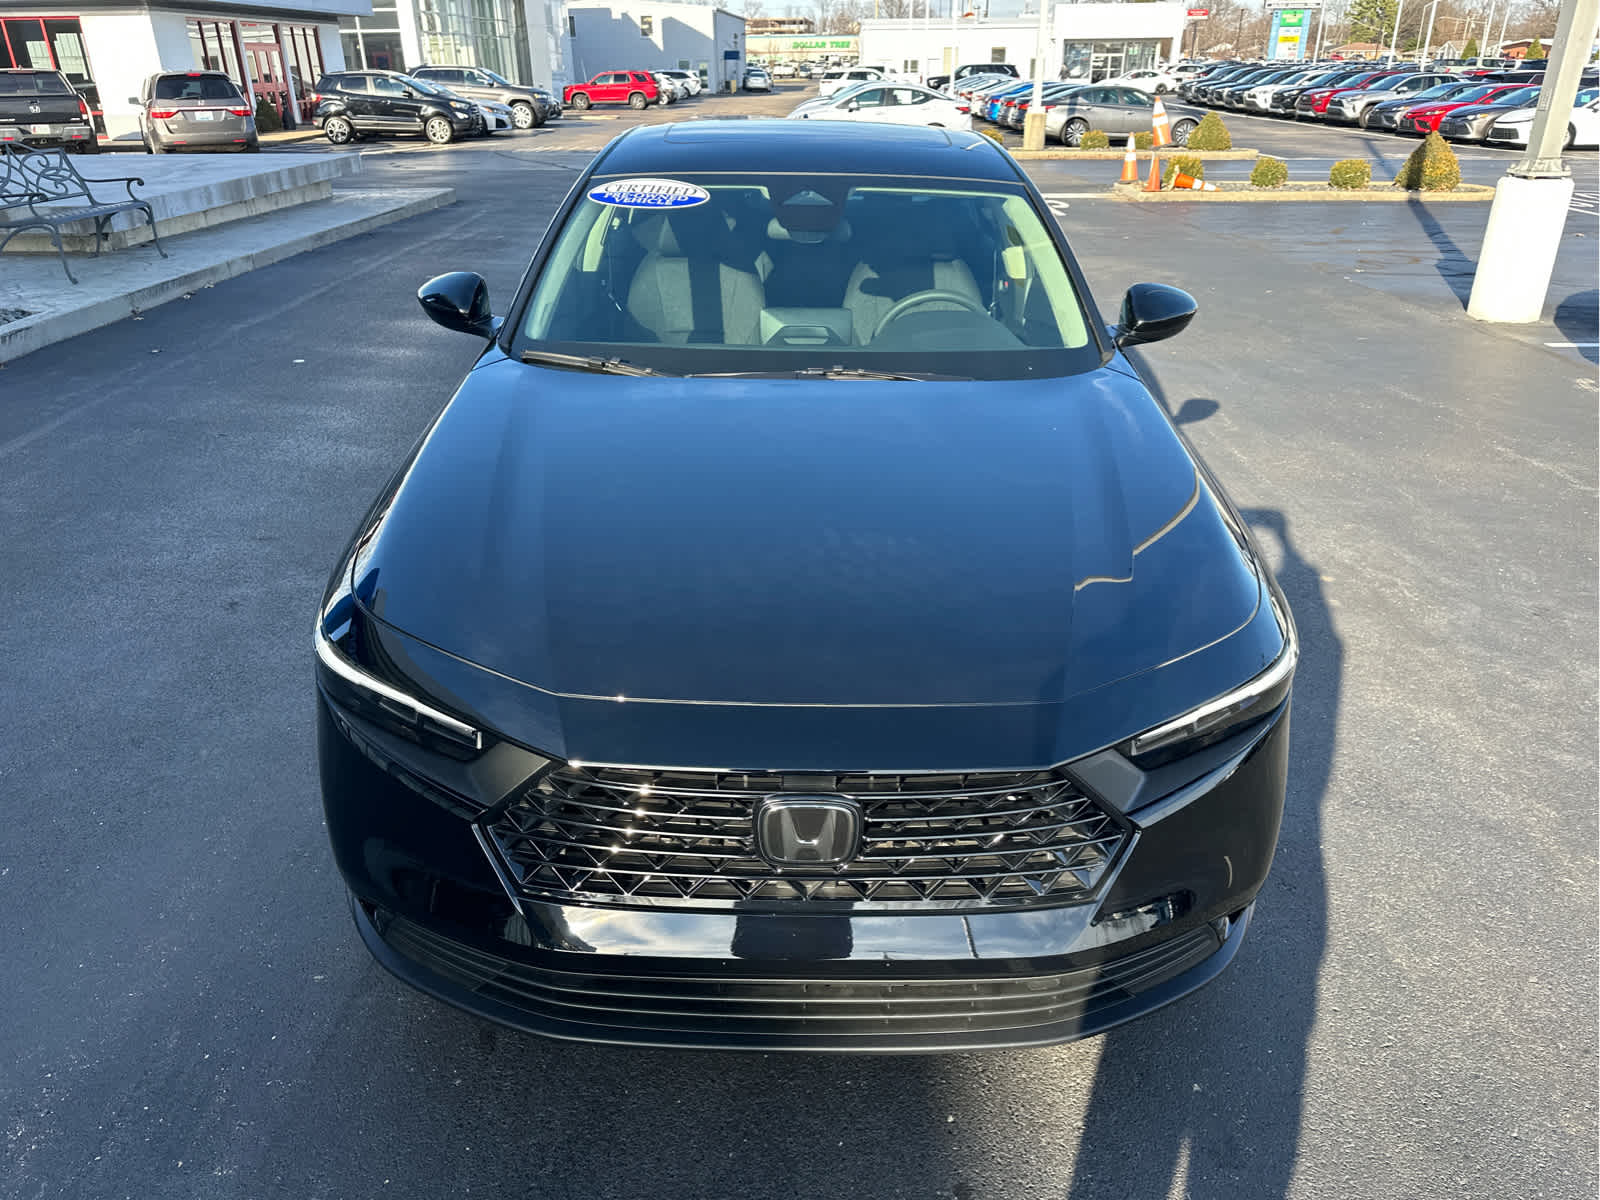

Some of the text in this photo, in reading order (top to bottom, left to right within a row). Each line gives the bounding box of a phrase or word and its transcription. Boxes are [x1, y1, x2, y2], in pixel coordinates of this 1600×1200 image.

[792, 41, 826, 49] DOLLAR
[604, 184, 698, 195] CERTIFIED
[614, 197, 673, 206] VEHICLE
